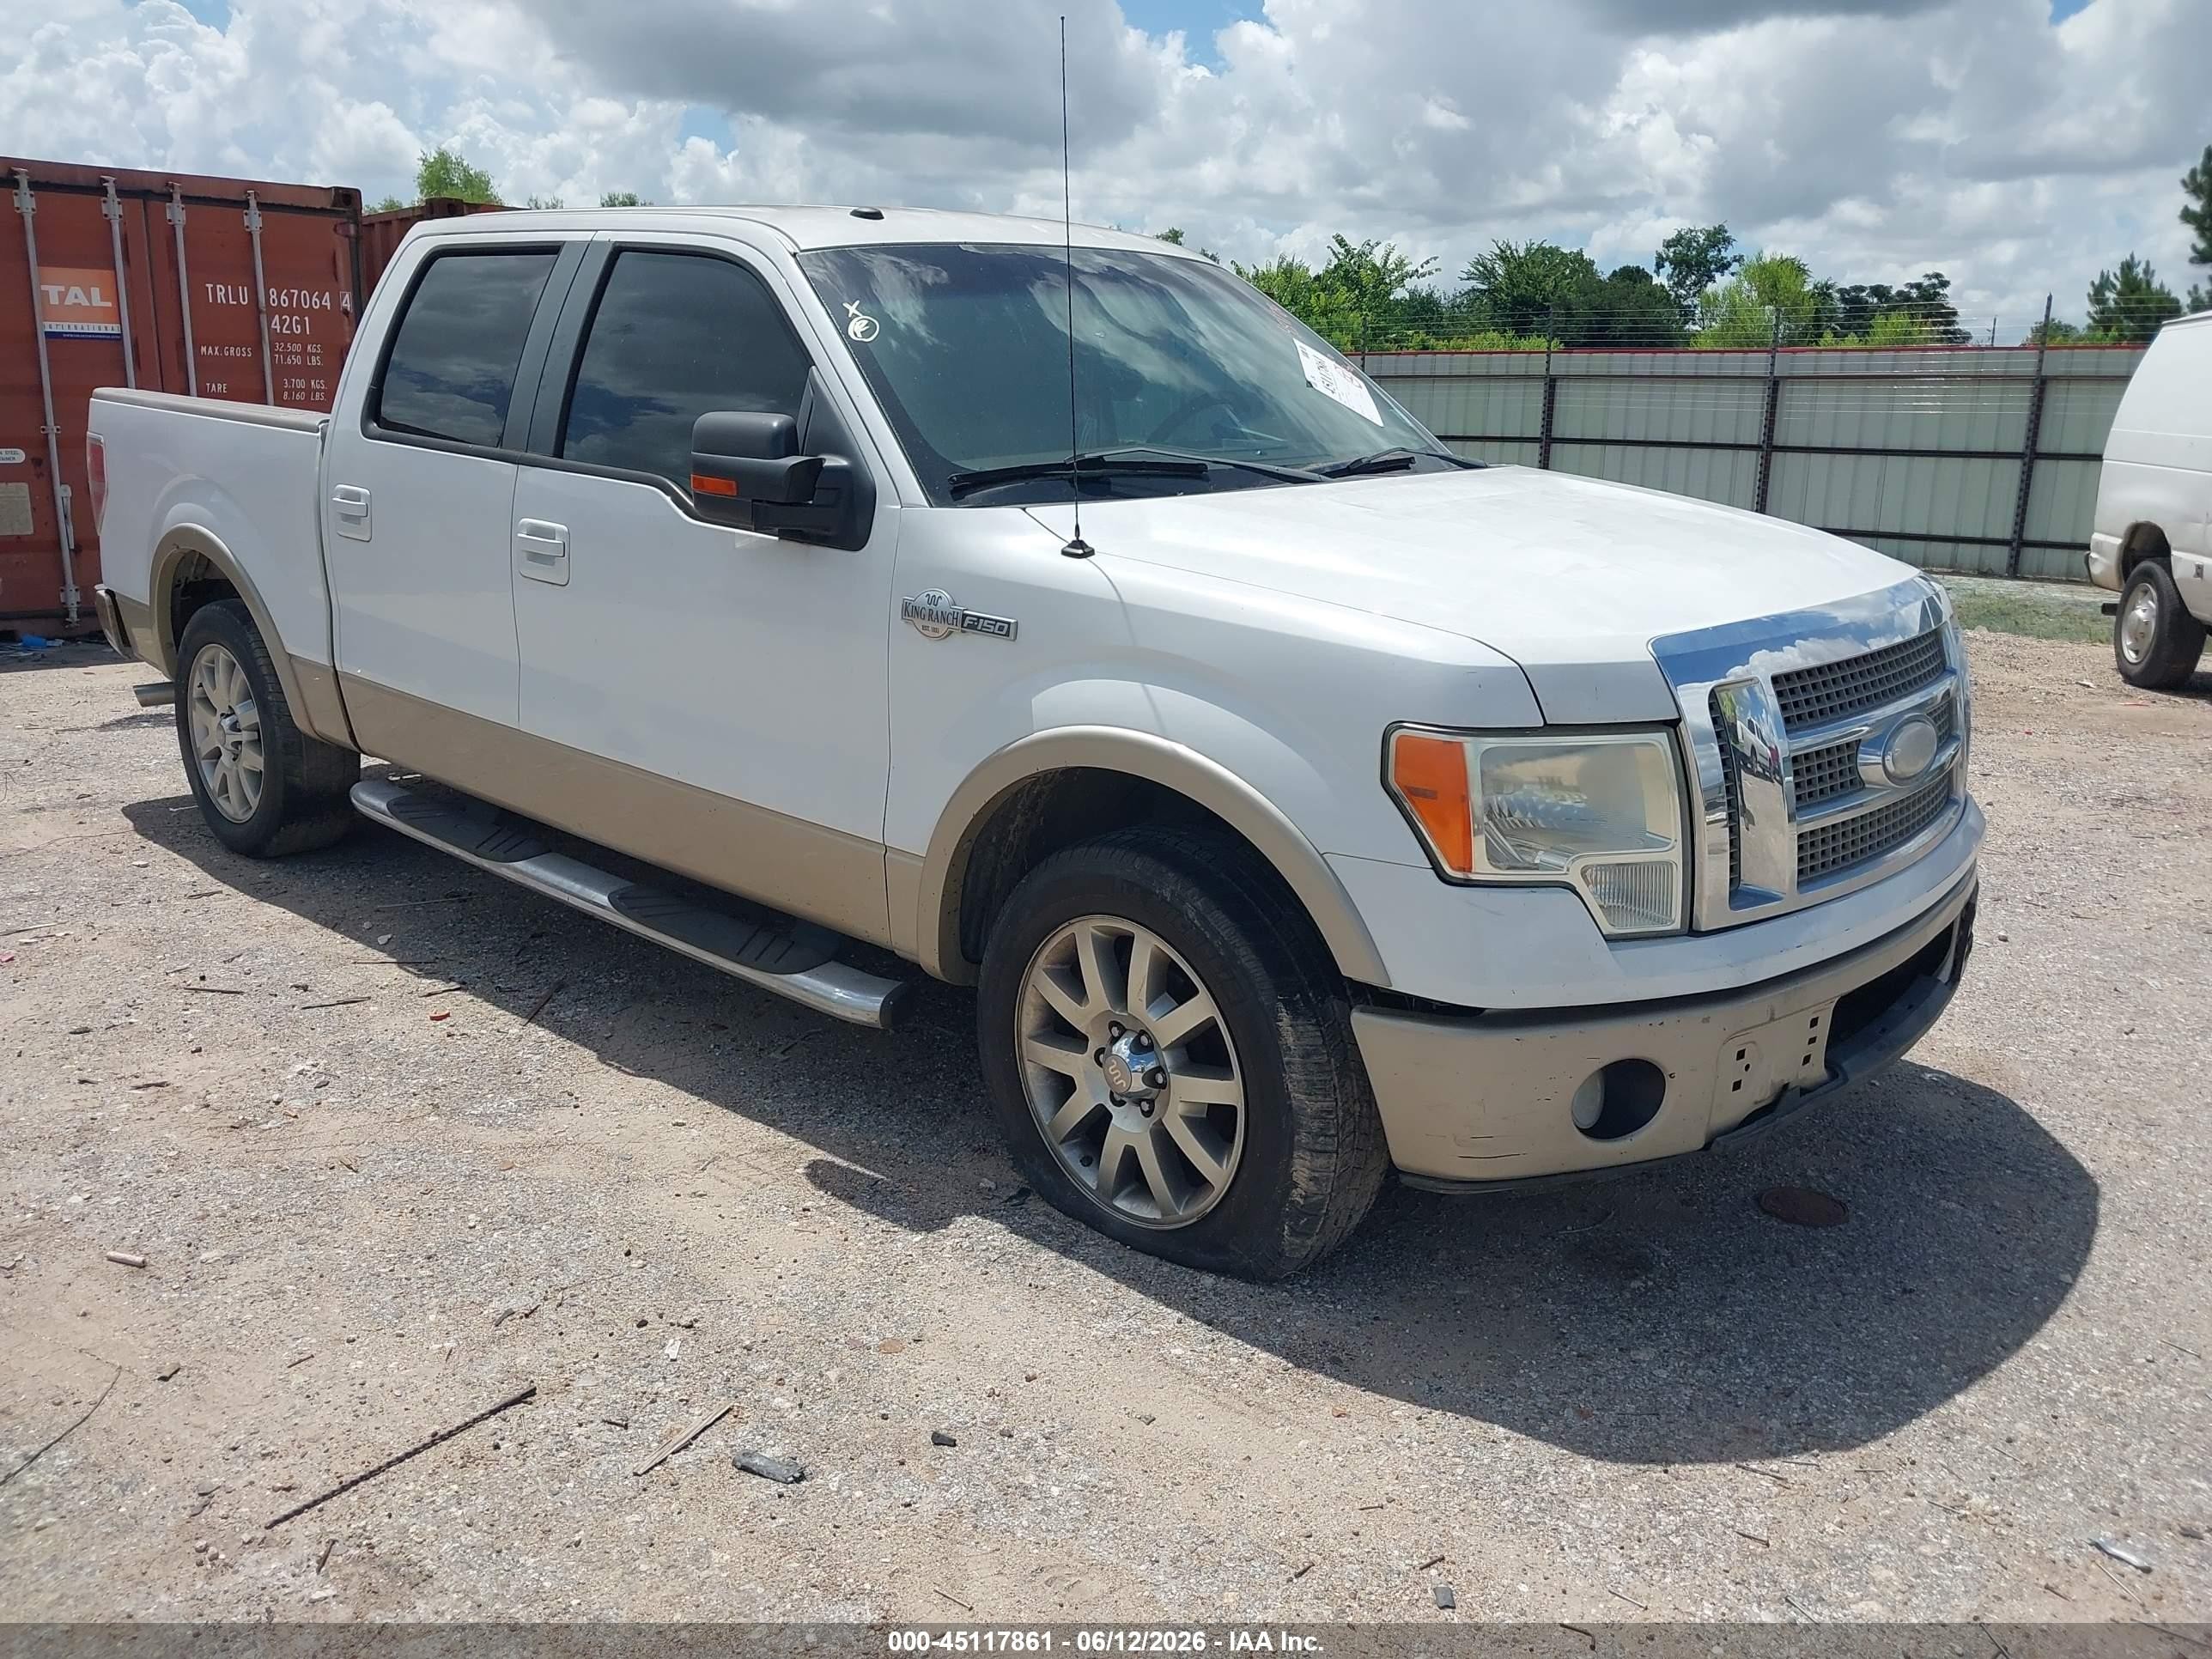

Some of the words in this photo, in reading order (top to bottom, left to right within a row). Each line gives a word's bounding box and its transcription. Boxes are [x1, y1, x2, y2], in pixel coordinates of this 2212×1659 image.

[40, 284, 112, 307] TAL
[205, 283, 248, 305] TRLU
[269, 288, 331, 311] 867064
[342, 293, 351, 312] 4
[270, 314, 310, 335] 42G1
[274, 342, 302, 352] 32.500
[307, 343, 324, 354] KGS.
[274, 355, 301, 365] 71.650
[307, 356, 324, 366] LBS.
[205, 383, 228, 393] TARE
[283, 378, 306, 389] 3.700
[310, 379, 328, 390] KGS.
[283, 391, 306, 400] 8.160
[310, 392, 327, 401] LBS.
[904, 601, 927, 620] KING
[927, 609, 960, 628] RANCH
